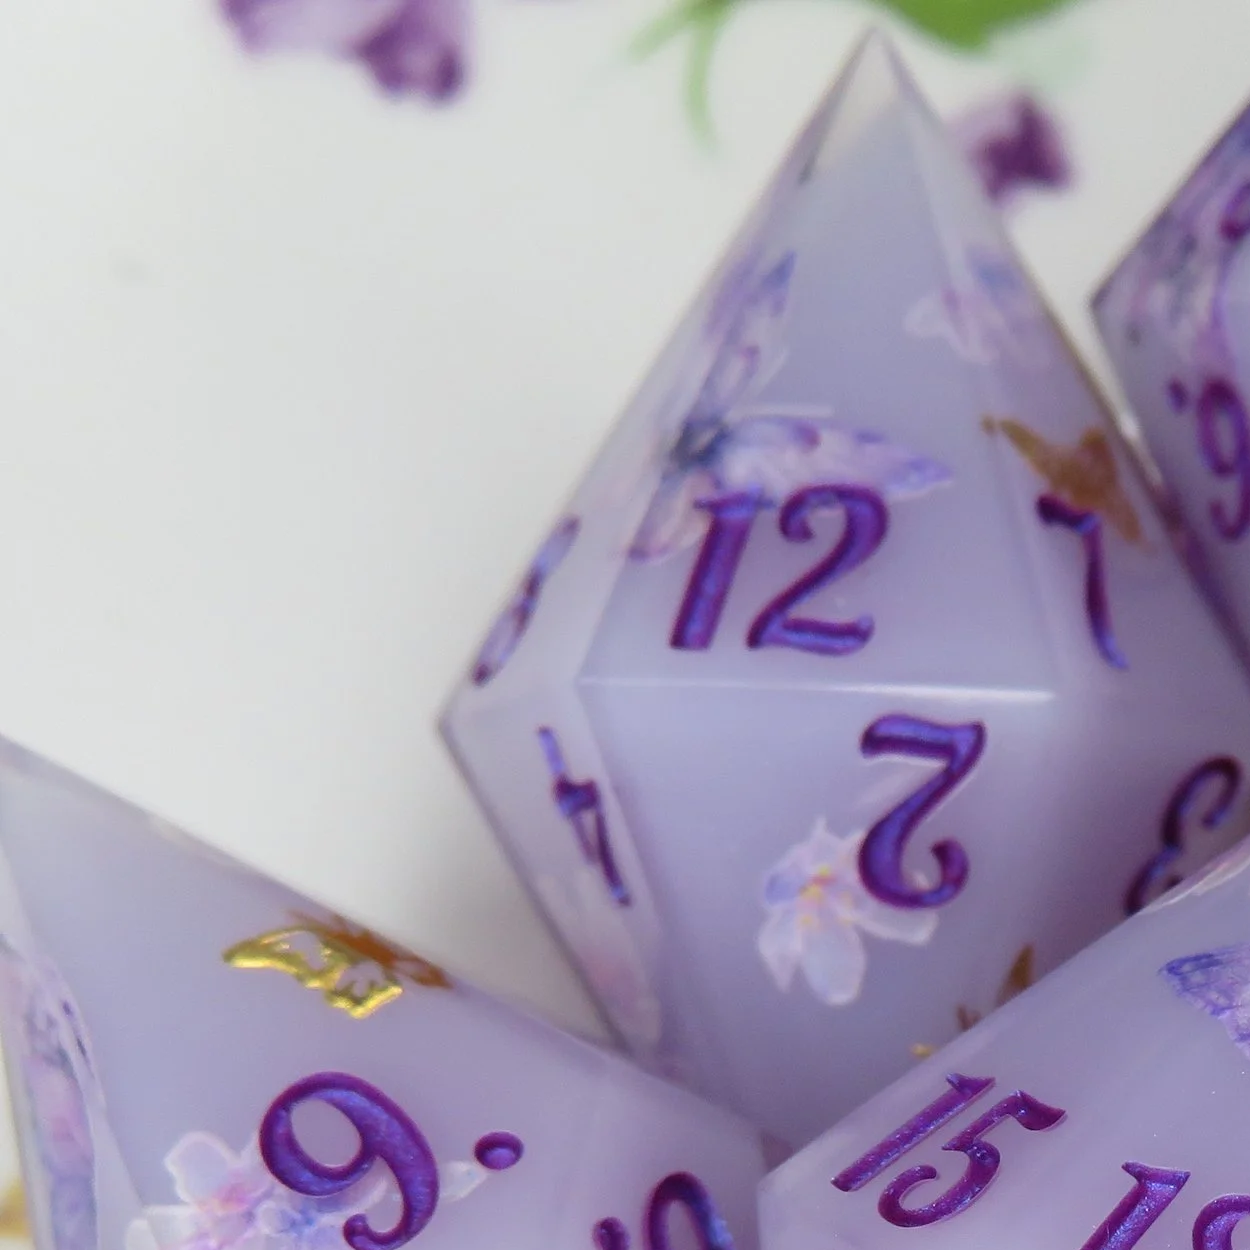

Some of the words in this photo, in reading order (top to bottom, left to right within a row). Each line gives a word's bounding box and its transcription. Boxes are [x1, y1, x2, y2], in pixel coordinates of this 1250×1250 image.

[669, 483, 889, 656] 12
[858, 713, 987, 909] 2
[830, 1073, 1066, 1228] 15
